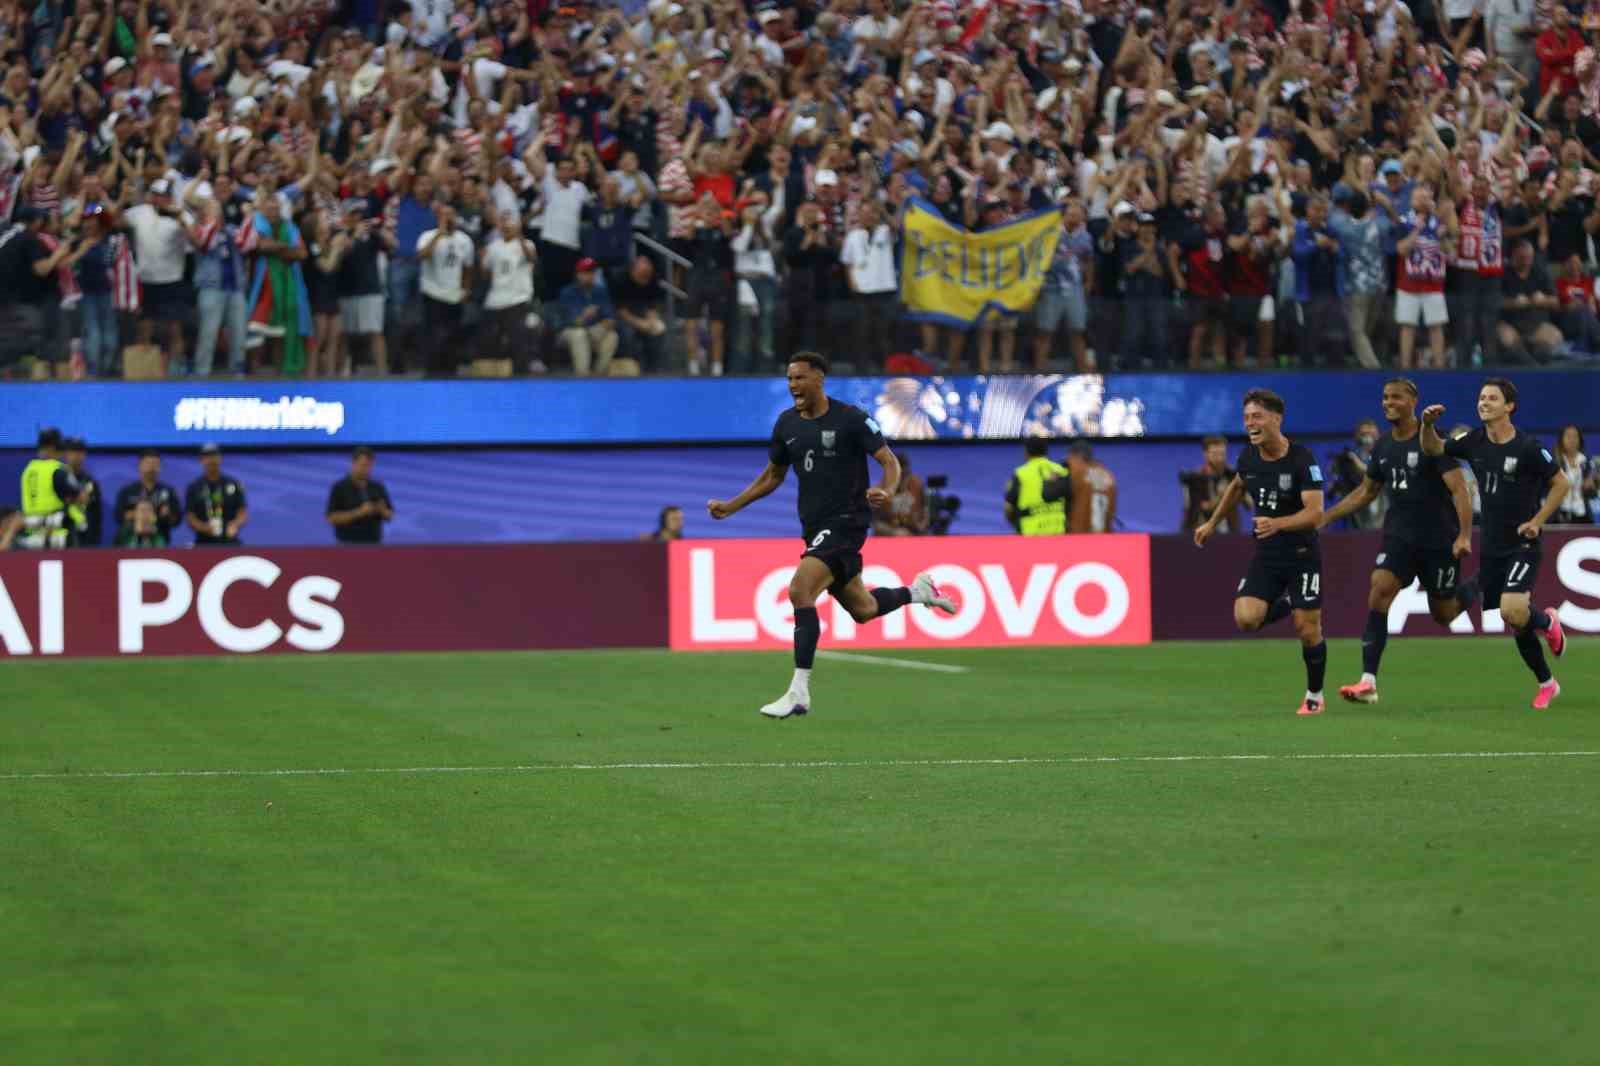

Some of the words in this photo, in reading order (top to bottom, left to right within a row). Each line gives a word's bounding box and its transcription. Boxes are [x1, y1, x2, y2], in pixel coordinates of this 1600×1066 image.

[804, 449, 815, 472] 6
[1391, 467, 1408, 490] 12
[1484, 471, 1499, 494] 11
[1259, 487, 1278, 510] 14
[812, 529, 831, 547] 6
[1436, 566, 1455, 589] 12
[1507, 561, 1530, 582] 11
[1301, 572, 1320, 595] 14
[117, 555, 346, 653] PCs
[689, 548, 1130, 643] Lenovo
